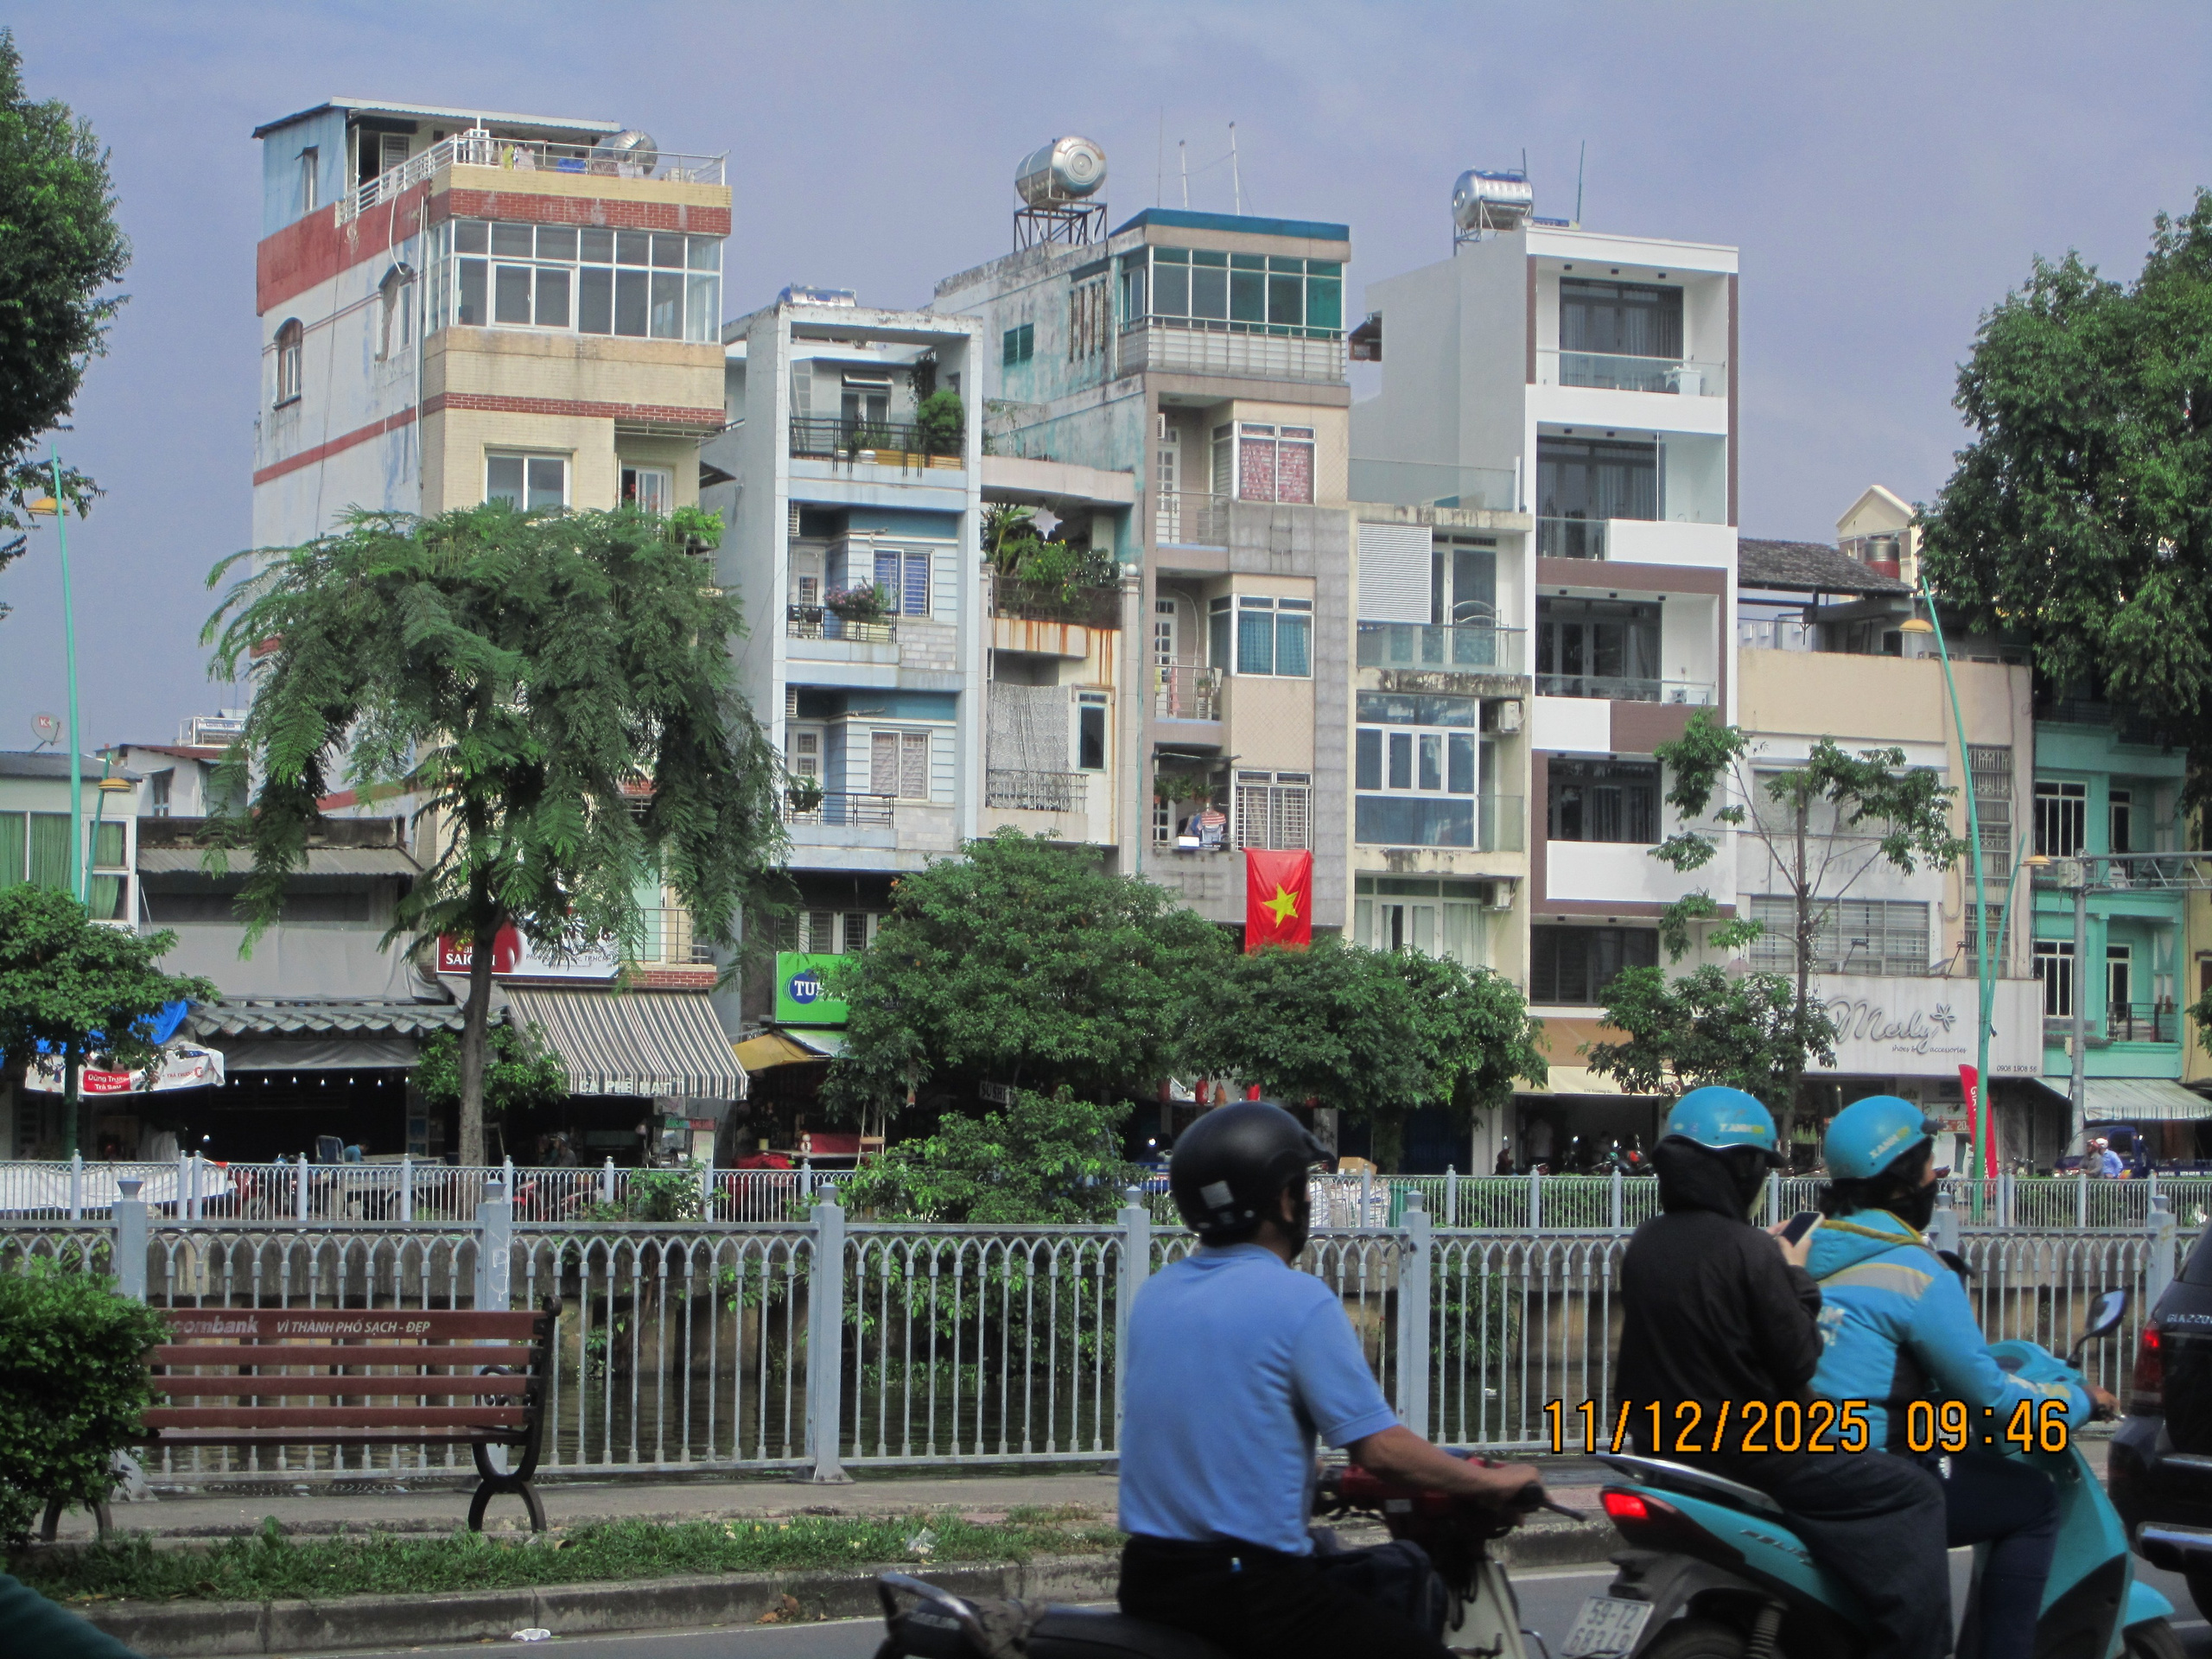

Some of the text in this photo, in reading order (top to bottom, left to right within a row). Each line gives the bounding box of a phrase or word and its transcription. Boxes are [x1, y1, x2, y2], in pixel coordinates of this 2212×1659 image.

[1929, 1045, 1967, 1054] accessories
[605, 1077, 633, 1094] PHÊ
[982, 1083, 1006, 1102] SUSHI
[276, 1319, 290, 1333] VÌ
[291, 1318, 334, 1333] THÀNH
[335, 1317, 363, 1334] PHỐ
[364, 1320, 397, 1336] SẠCH
[405, 1320, 430, 1336] ĐẸP
